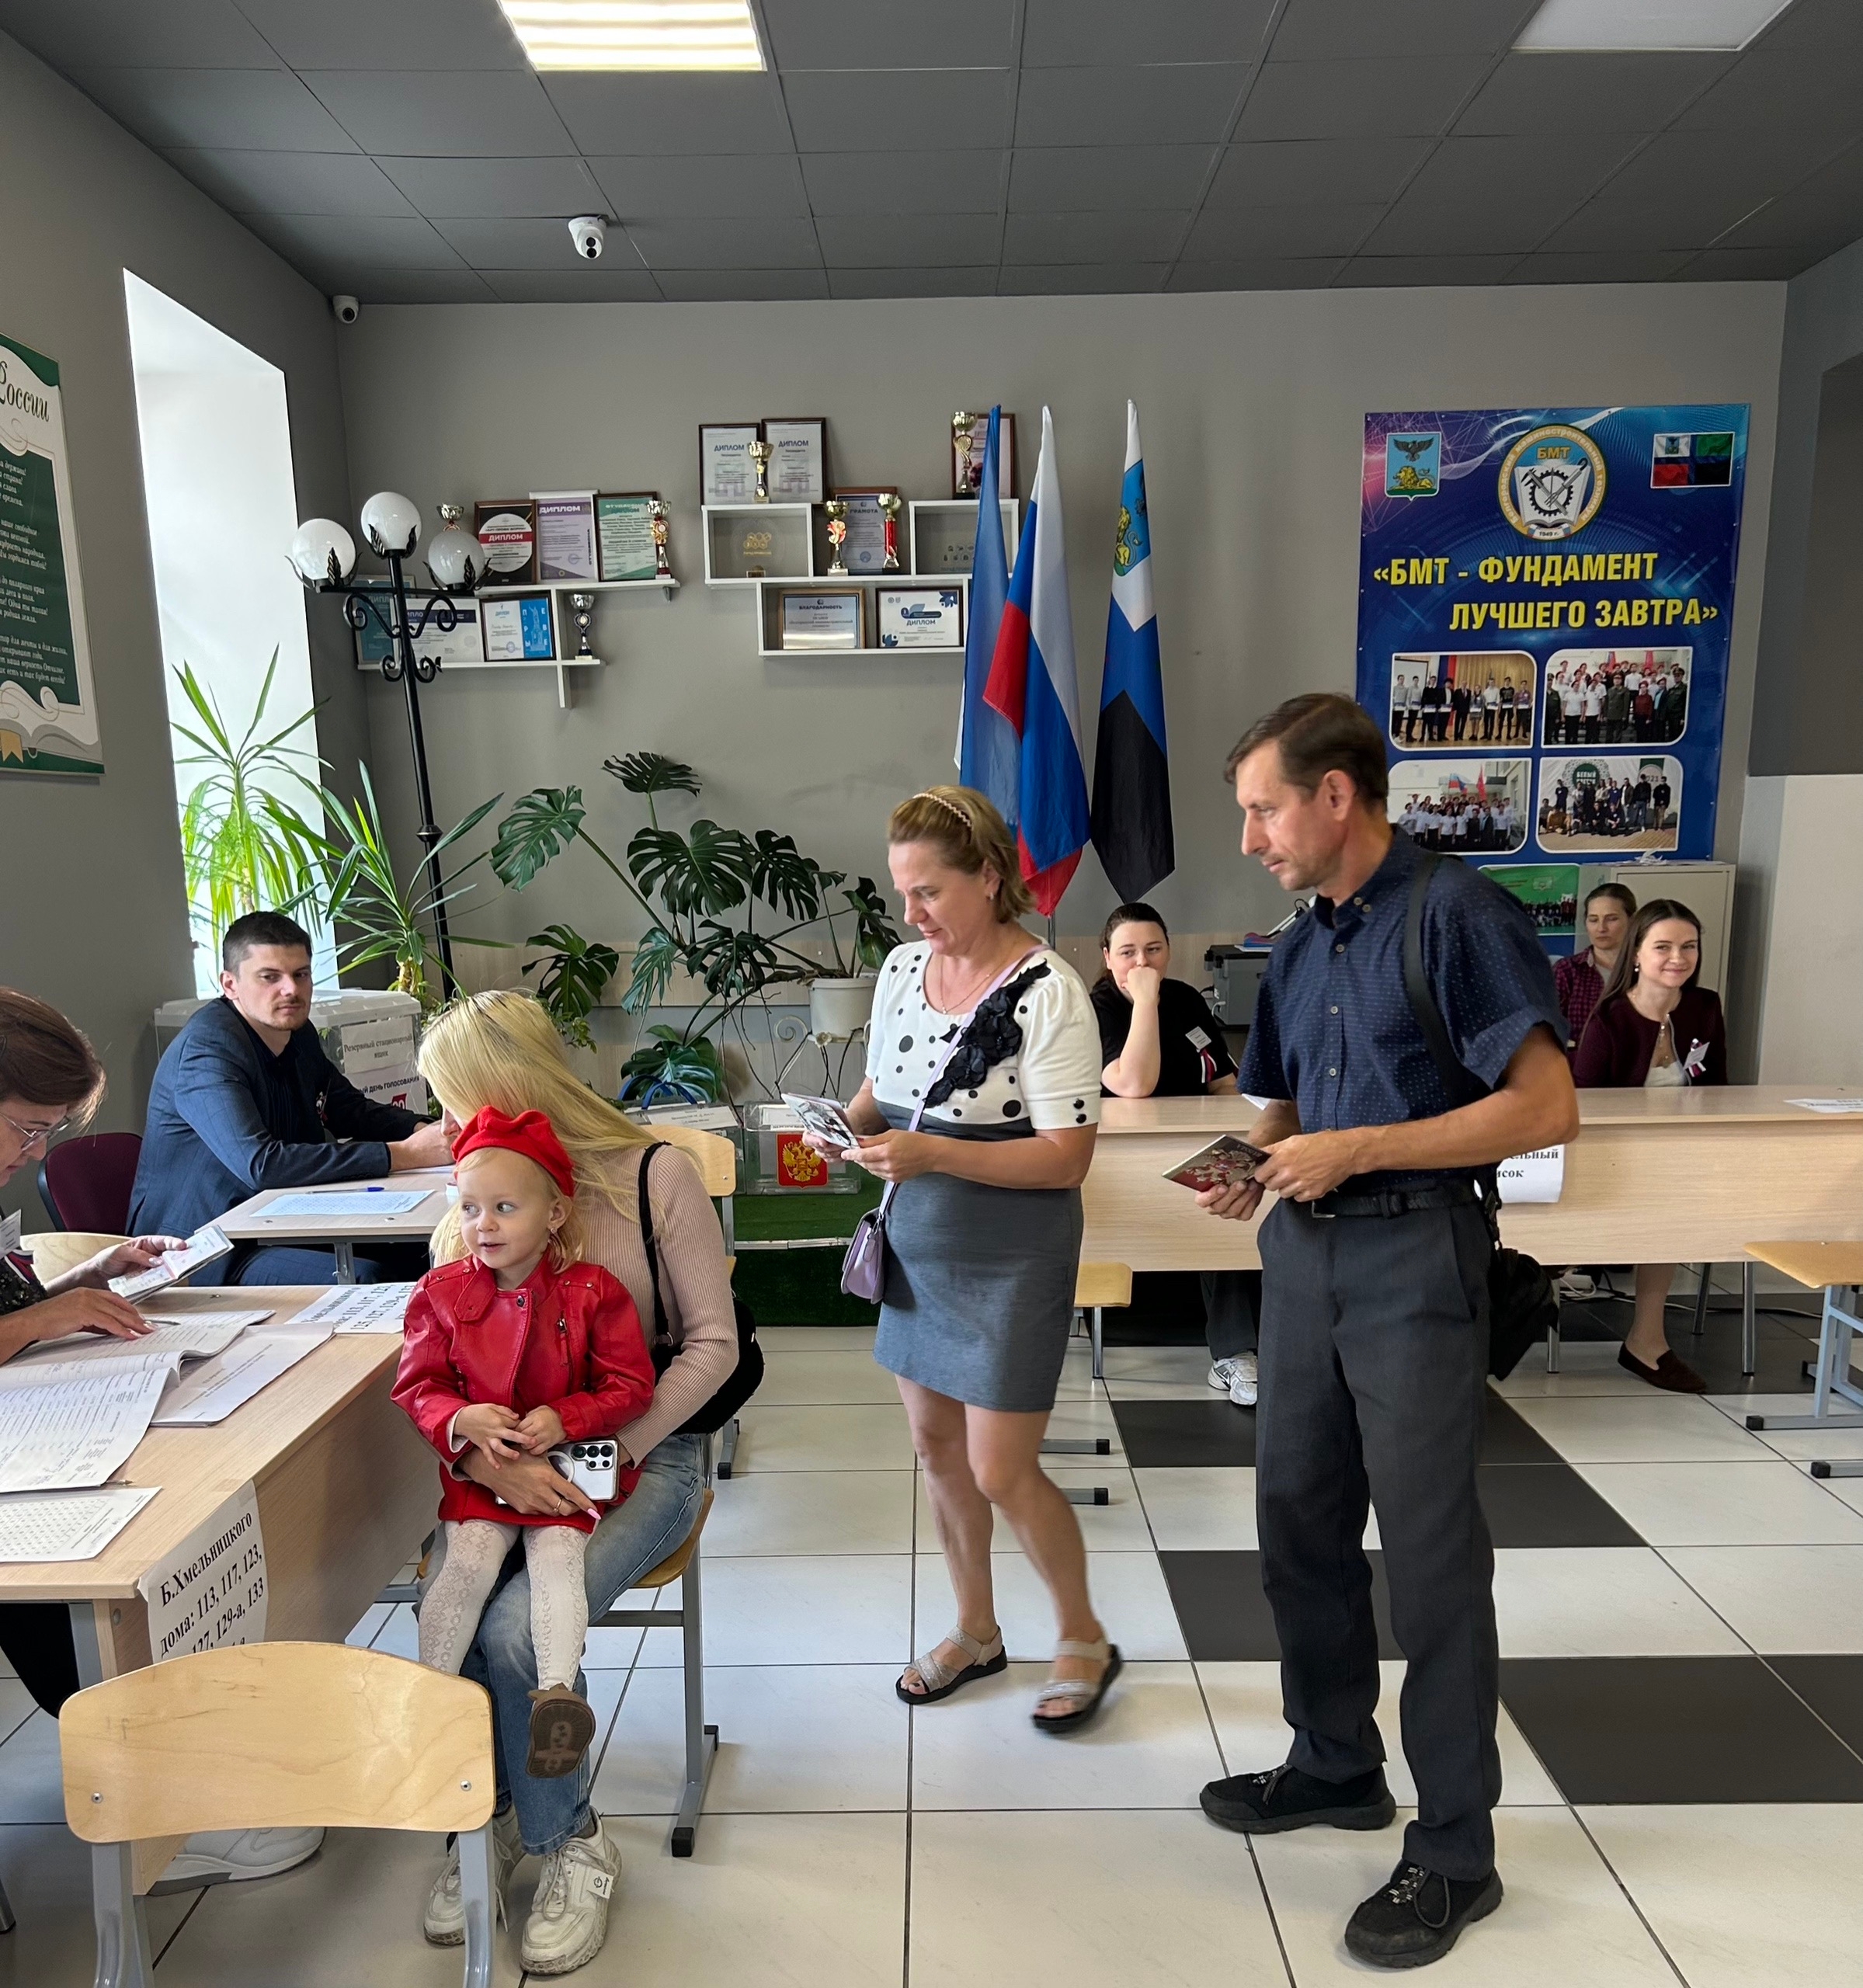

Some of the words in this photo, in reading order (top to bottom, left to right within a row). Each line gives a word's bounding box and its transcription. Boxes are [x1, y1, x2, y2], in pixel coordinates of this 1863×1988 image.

[1537, 447, 1570, 459] БМТ
[539, 506, 581, 514] ДИПЛОМ
[488, 533, 523, 542] ДИПЛОМ
[1373, 558, 1449, 586] «БМТ
[1479, 553, 1658, 586] ФУНДАМЕНТ
[1449, 600, 1586, 631] ЛУЧШЕГО
[1594, 597, 1719, 627] ЗАВТРА»
[344, 1041, 375, 1052] Резервный
[376, 1034, 412, 1047] стационарный
[369, 1084, 384, 1093] ДЕНЬ
[384, 1076, 419, 1089] ГОЛОСОВАНИЯ
[160, 1513, 252, 1607] Б.Хмельницкого
[160, 1611, 194, 1659] дома:
[196, 1586, 220, 1621] 113,
[221, 1562, 242, 1597] 117,
[243, 1543, 262, 1574] 123,
[216, 1604, 246, 1642] 129-а,
[248, 1576, 264, 1608] 133
